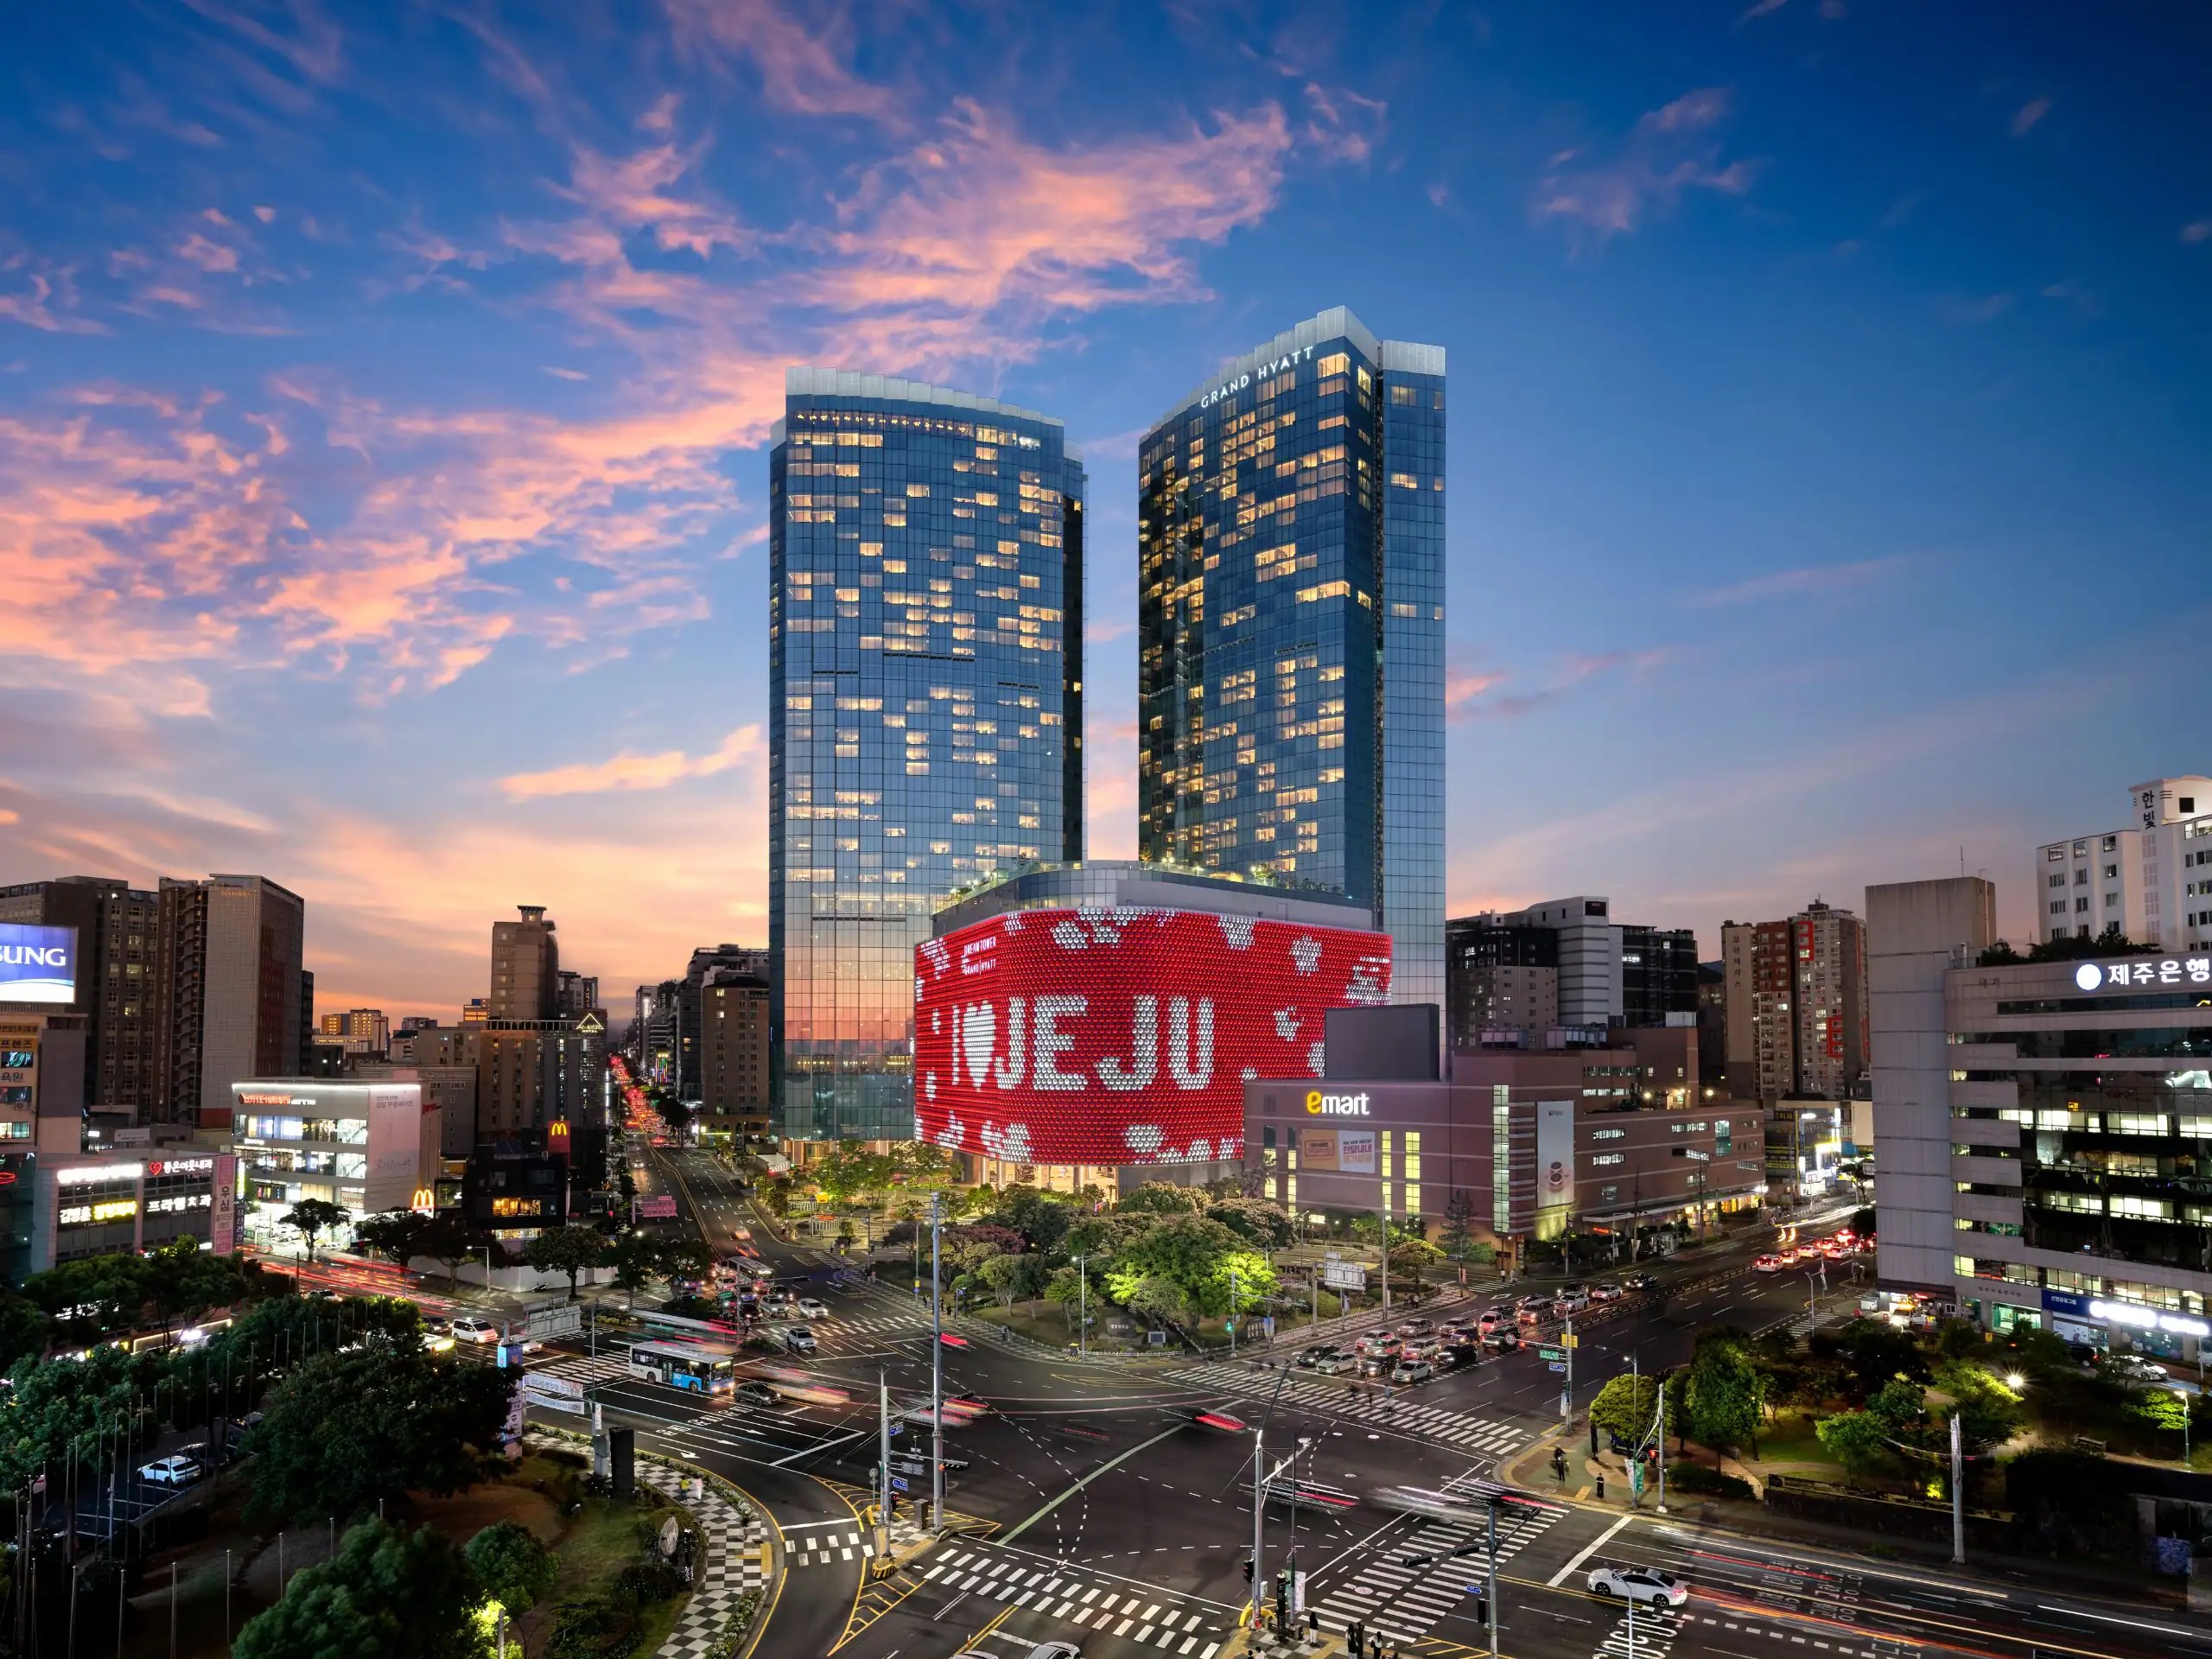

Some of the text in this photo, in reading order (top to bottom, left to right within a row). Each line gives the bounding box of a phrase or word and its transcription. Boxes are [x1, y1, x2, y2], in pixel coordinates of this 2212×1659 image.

[1201, 346, 1313, 409] GRAND HYATT
[2142, 790, 2156, 830] 한빛
[0, 945, 66, 966] UNG
[980, 937, 996, 950] TOWER
[982, 959, 996, 971] HYATT
[2108, 958, 2209, 985] 제주은행
[996, 994, 1215, 1091] JEJU
[1306, 1091, 1370, 1115] emart
